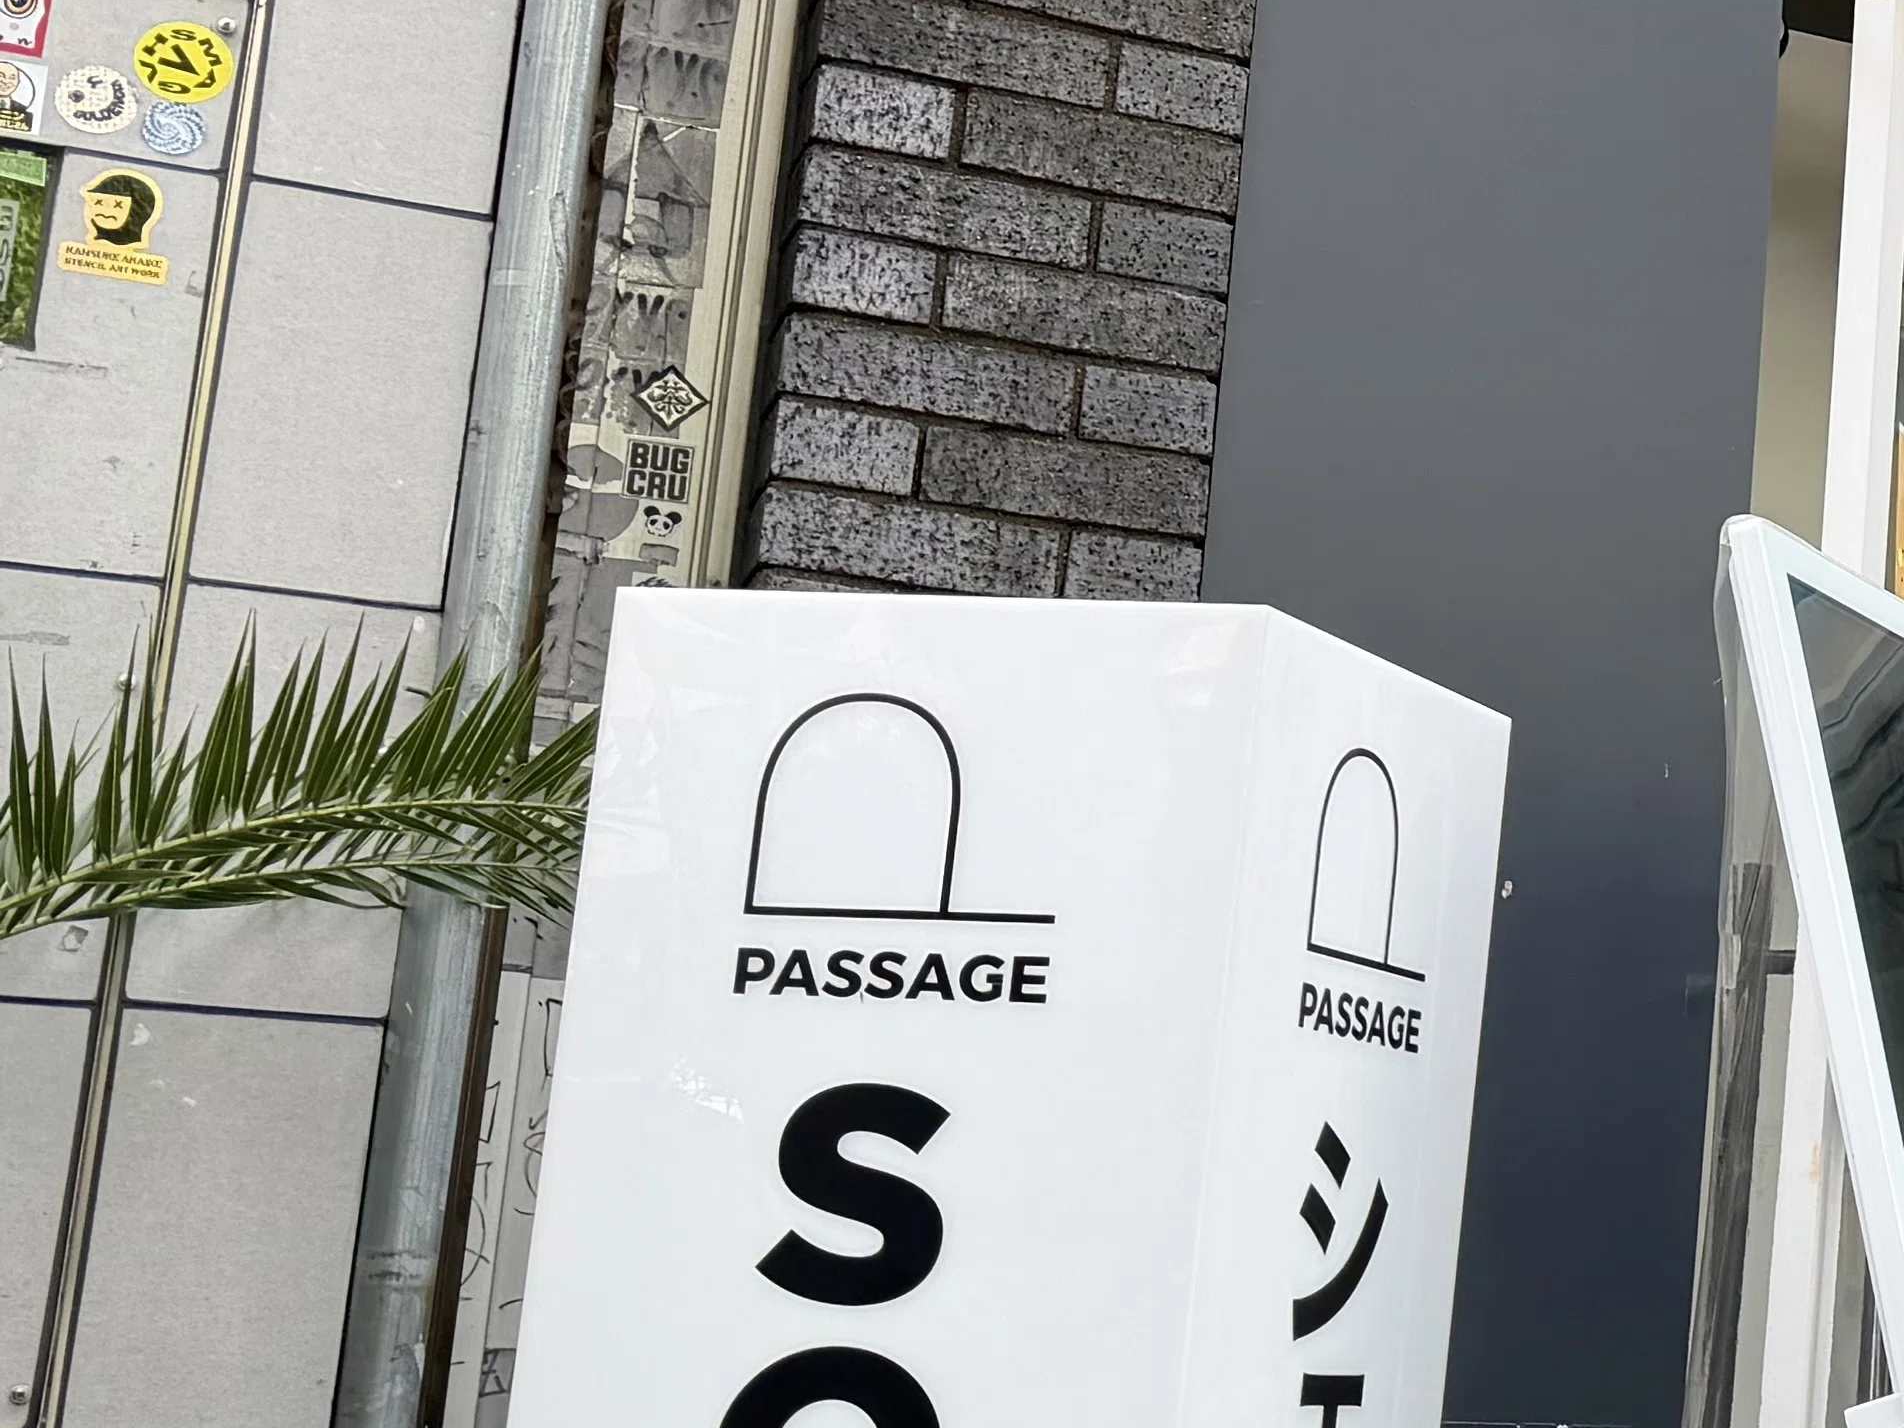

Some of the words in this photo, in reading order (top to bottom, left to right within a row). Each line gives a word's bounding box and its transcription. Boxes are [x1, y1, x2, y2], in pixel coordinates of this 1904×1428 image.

[628, 441, 690, 471] BUG
[626, 470, 688, 501] CRU
[732, 947, 1052, 1006] PASSAGE
[1298, 982, 1424, 1055] PASSAGE
